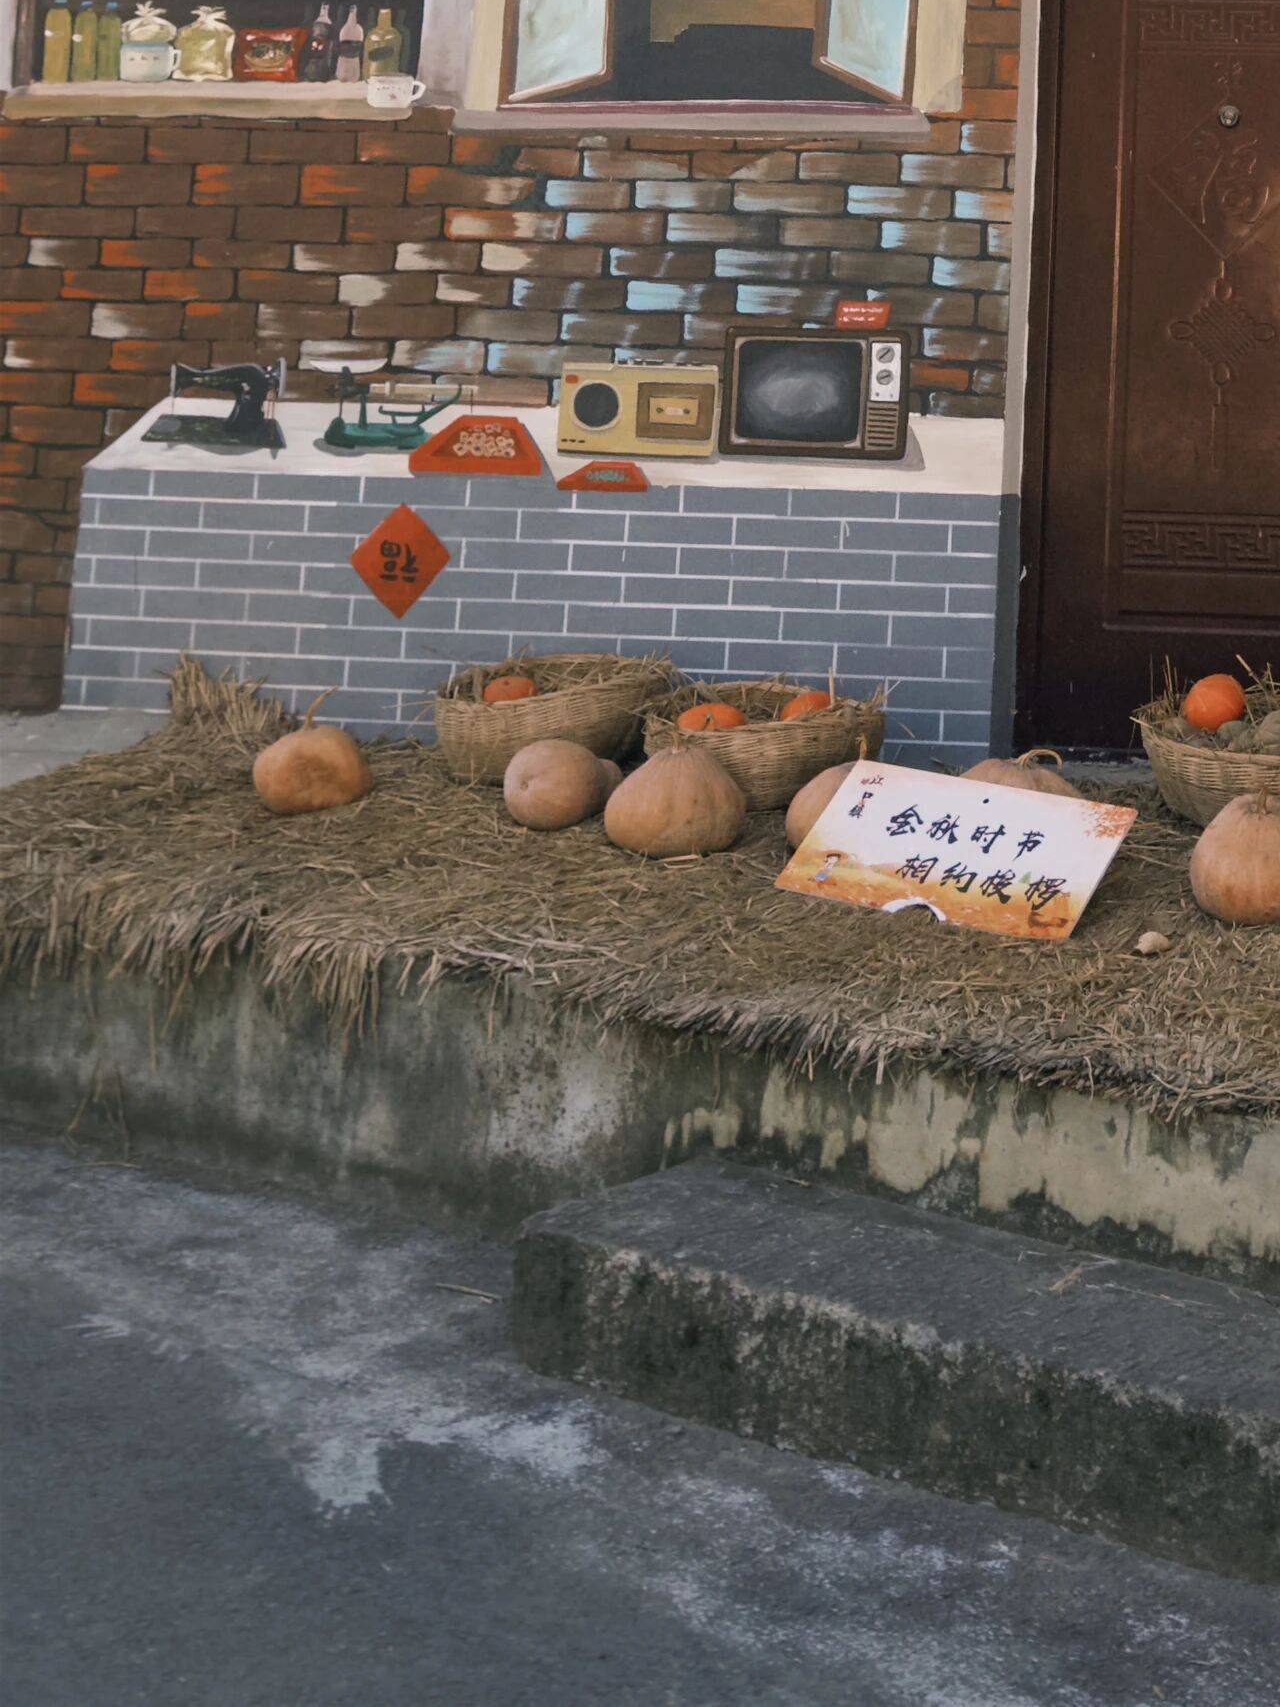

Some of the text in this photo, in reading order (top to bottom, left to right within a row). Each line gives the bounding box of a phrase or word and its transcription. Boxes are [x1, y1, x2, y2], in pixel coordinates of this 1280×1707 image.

[379, 539, 419, 583] 福
[886, 804, 1045, 861] 金秋时节
